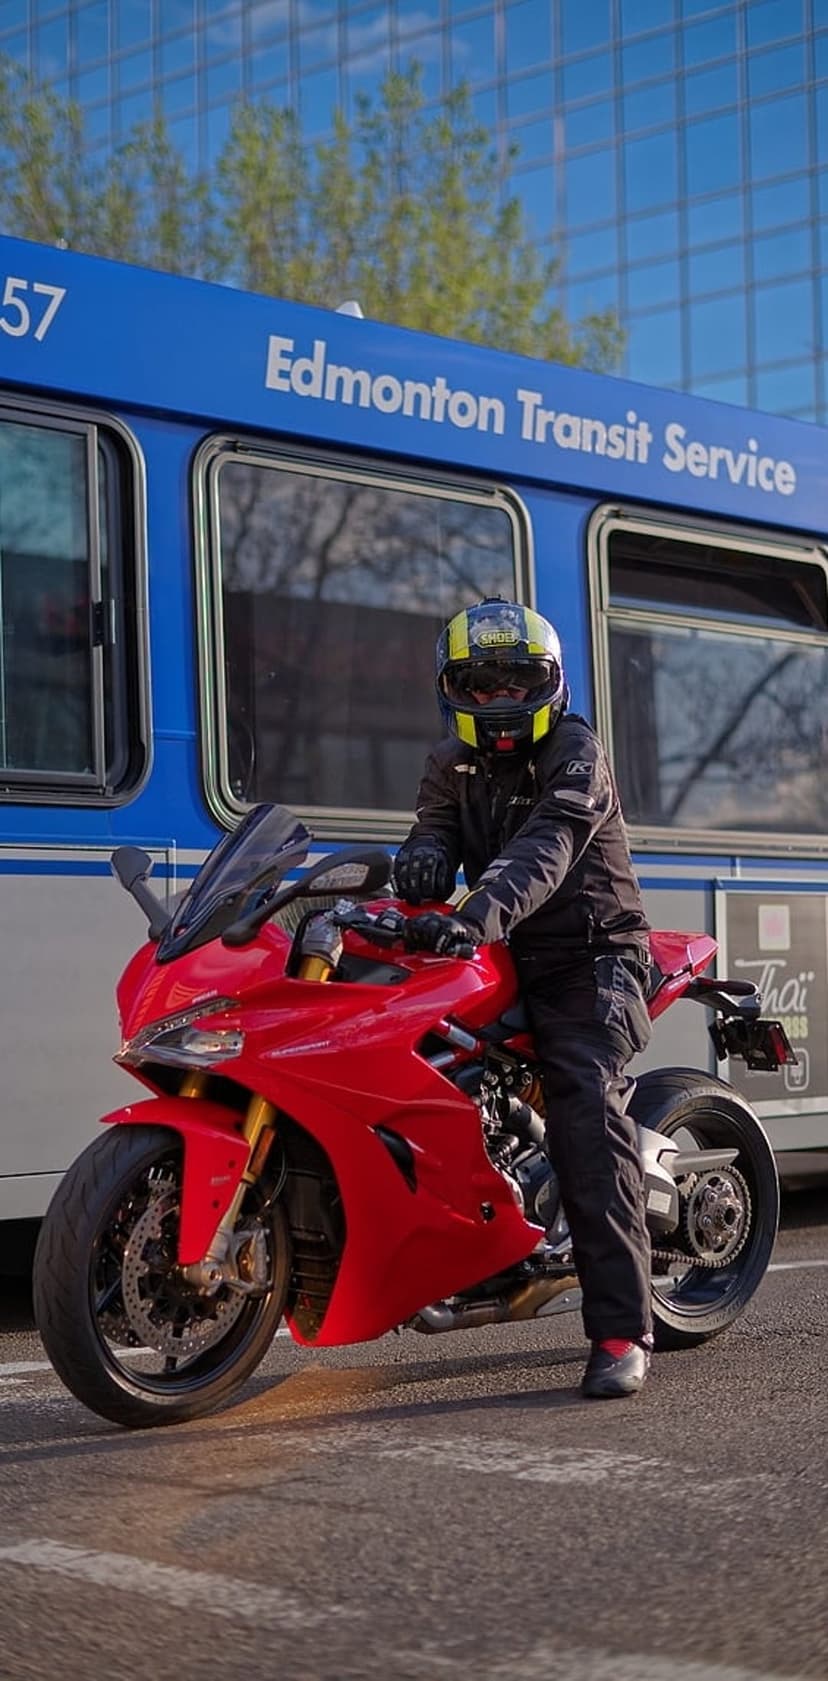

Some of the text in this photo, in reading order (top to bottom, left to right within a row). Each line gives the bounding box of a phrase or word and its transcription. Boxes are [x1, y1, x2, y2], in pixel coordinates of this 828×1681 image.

[0, 277, 67, 341] 57
[265, 335, 797, 495] Edmonton Transit Service
